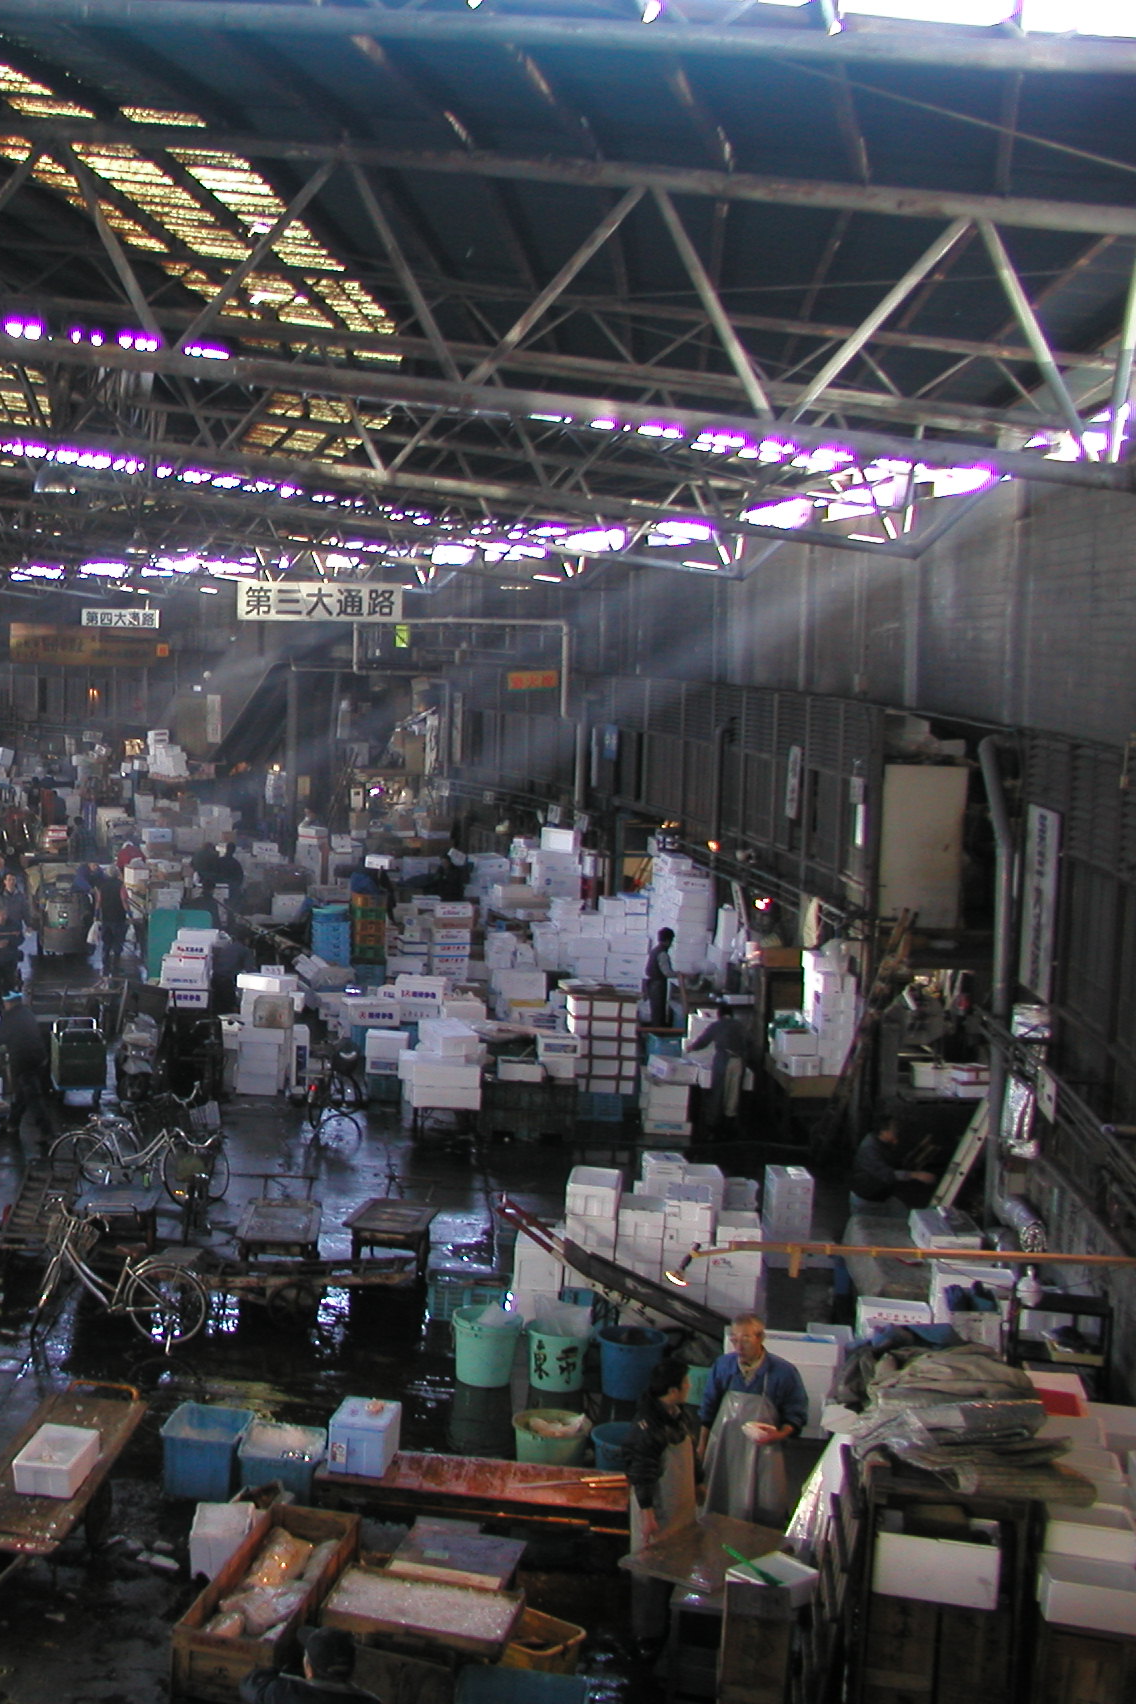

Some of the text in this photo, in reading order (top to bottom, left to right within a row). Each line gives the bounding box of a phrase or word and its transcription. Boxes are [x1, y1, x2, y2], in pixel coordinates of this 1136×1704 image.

[245, 586, 396, 617] 第三大通路
[86, 610, 156, 627] 第四大通路
